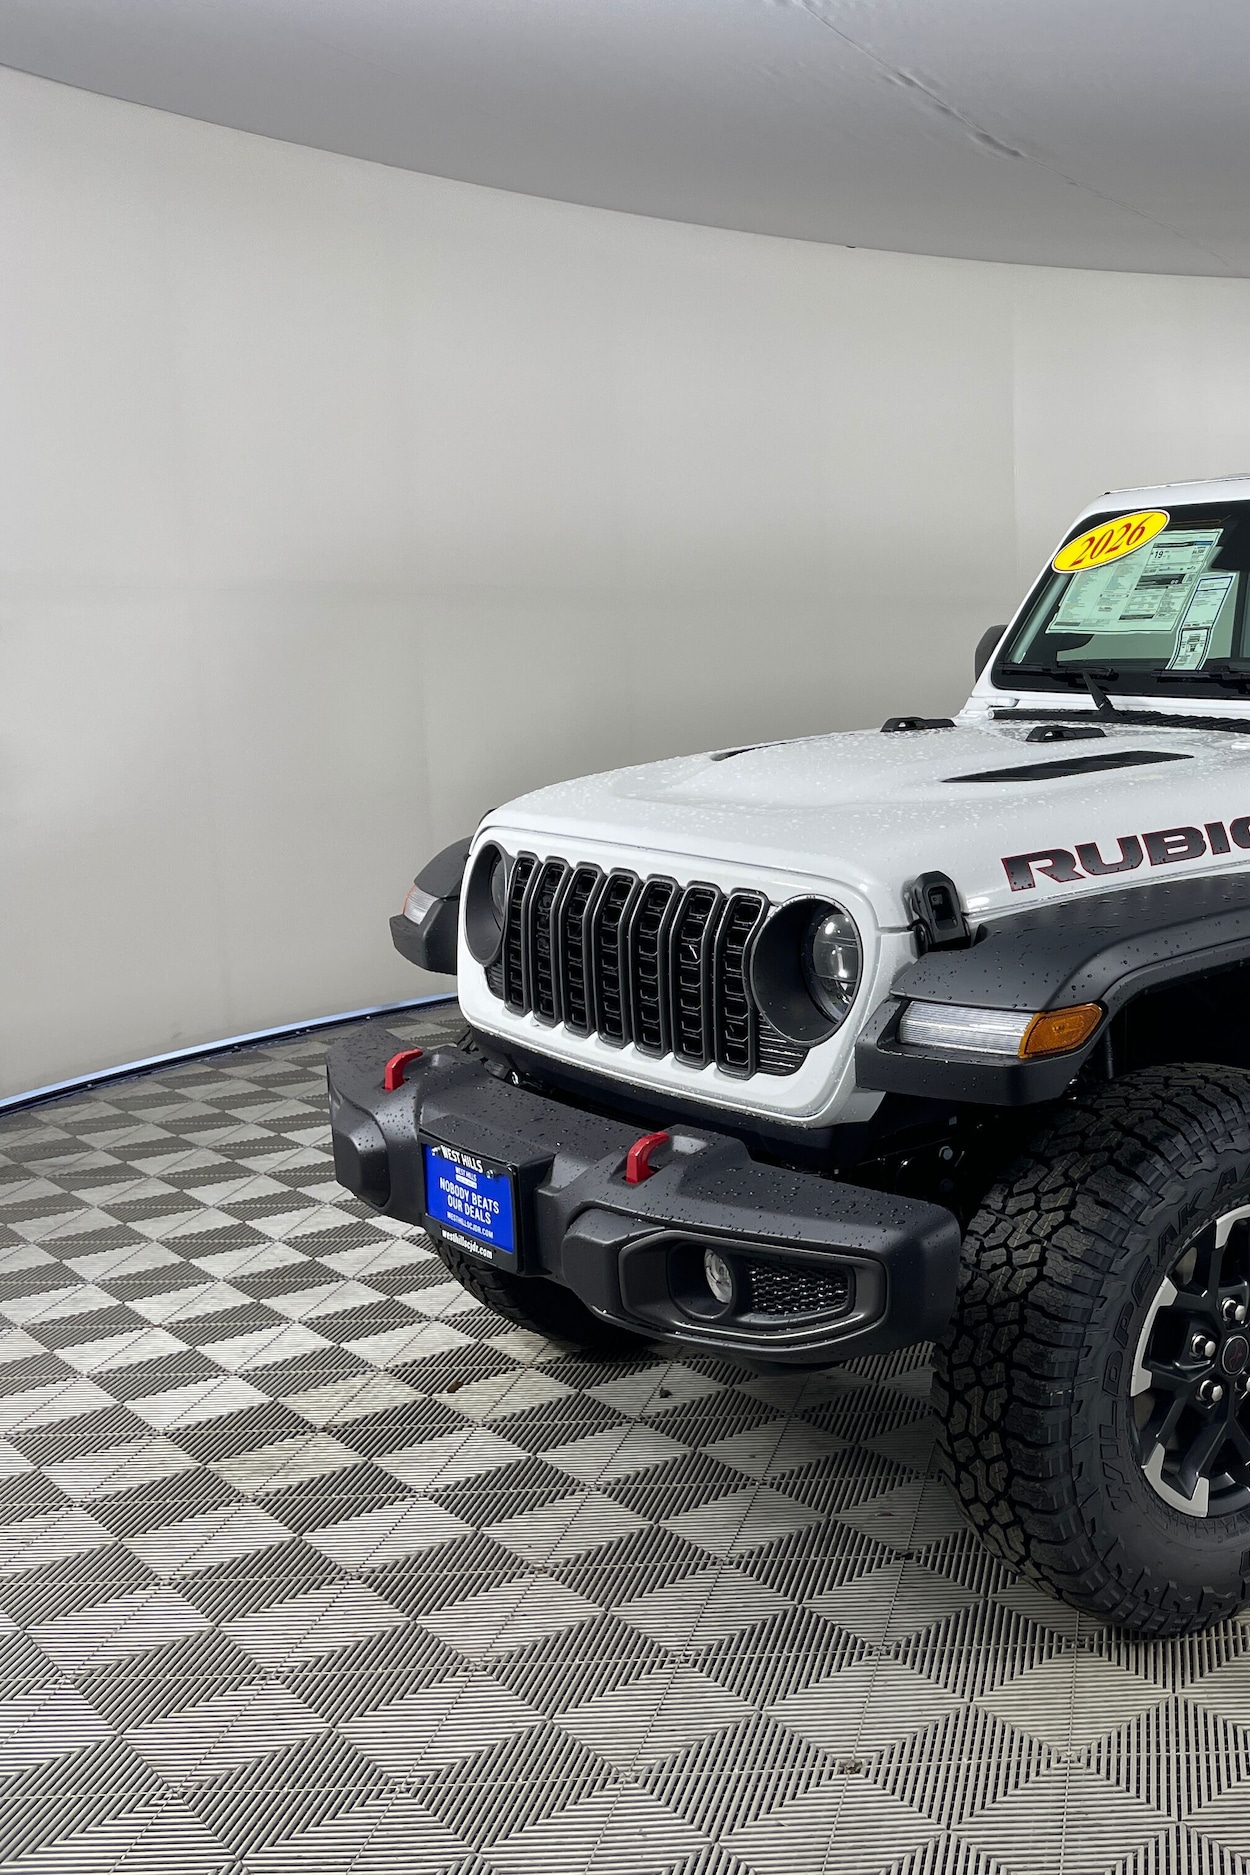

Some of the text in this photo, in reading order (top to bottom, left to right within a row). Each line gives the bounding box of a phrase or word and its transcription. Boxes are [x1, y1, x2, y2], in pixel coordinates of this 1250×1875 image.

[1068, 514, 1155, 568] 2026
[440, 1145, 483, 1173] WEST HILLS
[439, 1177, 470, 1202] NOBODY
[471, 1192, 500, 1214] BEATS
[447, 1194, 492, 1225] OUR DEALS
